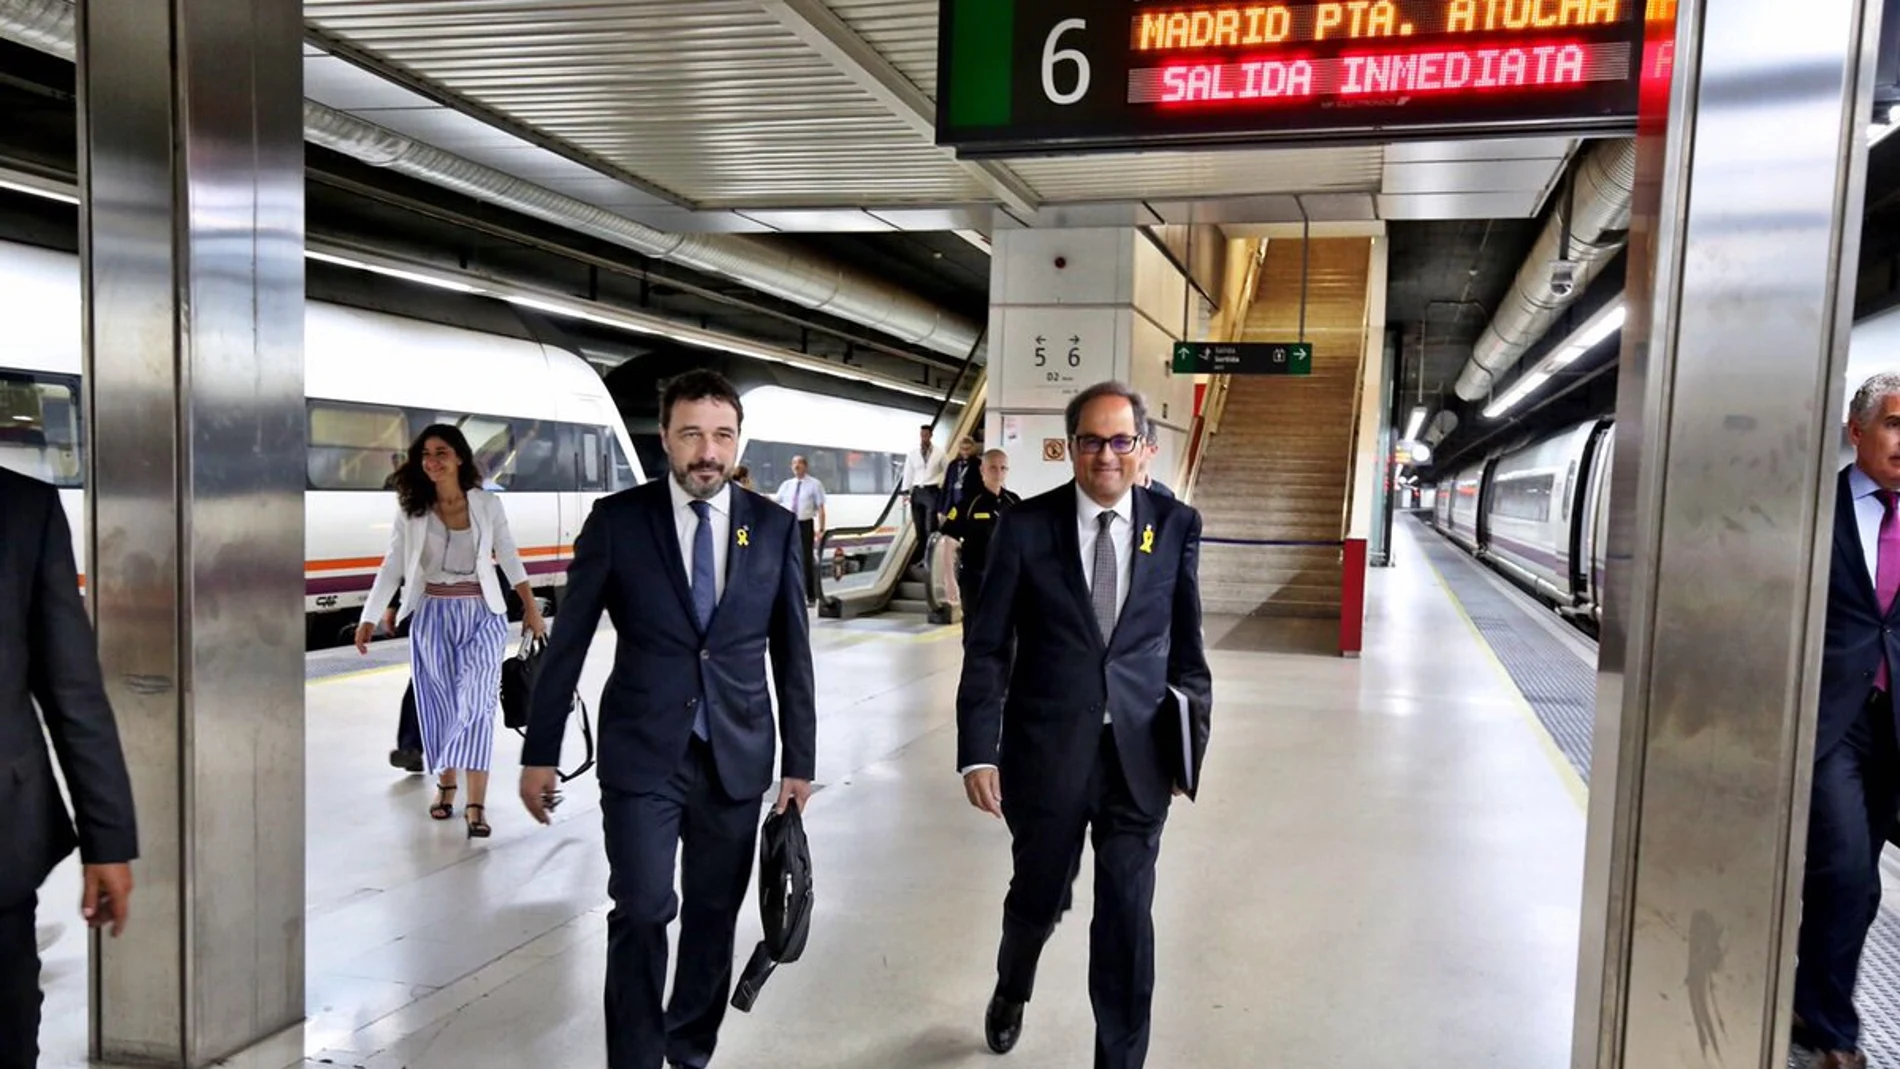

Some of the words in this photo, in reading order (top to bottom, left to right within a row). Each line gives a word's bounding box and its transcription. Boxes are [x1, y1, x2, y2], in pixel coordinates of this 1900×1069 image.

[1140, 6, 1291, 50] MADRID
[1314, 0, 1413, 41] PTA.
[1040, 18, 1092, 106] 6
[1161, 60, 1313, 102] SALIDA
[1340, 44, 1584, 94] INMEDIATA
[1035, 347, 1046, 367] 5
[1068, 347, 1081, 368] 6
